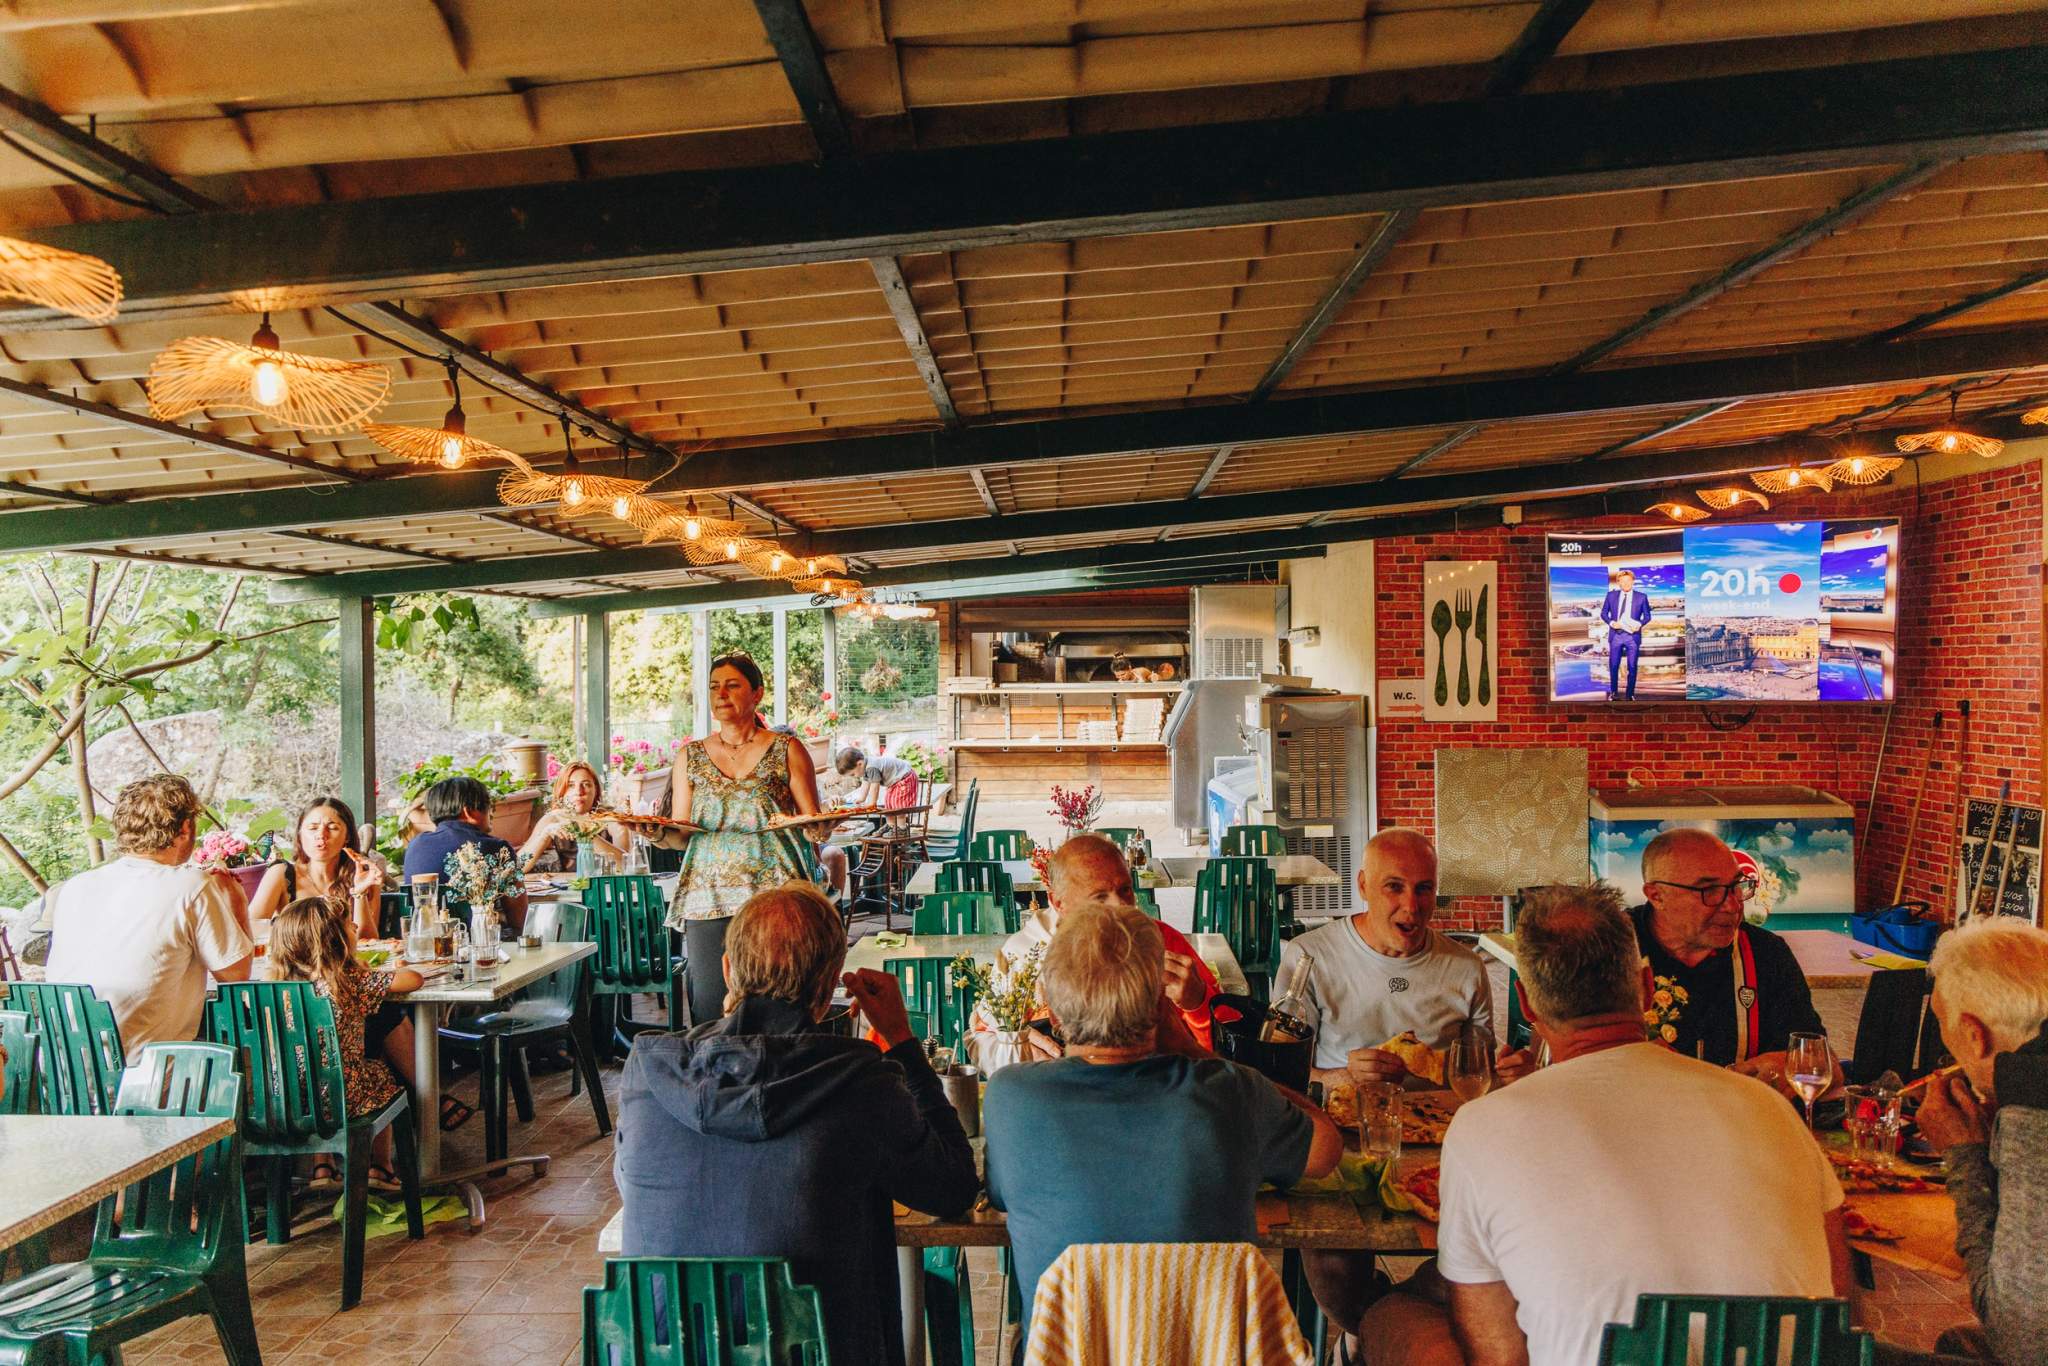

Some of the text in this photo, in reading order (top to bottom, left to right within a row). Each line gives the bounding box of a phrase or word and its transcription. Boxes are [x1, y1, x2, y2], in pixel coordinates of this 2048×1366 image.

[1561, 543, 1582, 552] 20h
[1701, 567, 1769, 596] 20h
[1701, 599, 1770, 611] week-end
[1393, 692, 1416, 700] W.C.
[1969, 802, 2006, 816] CHAQE
